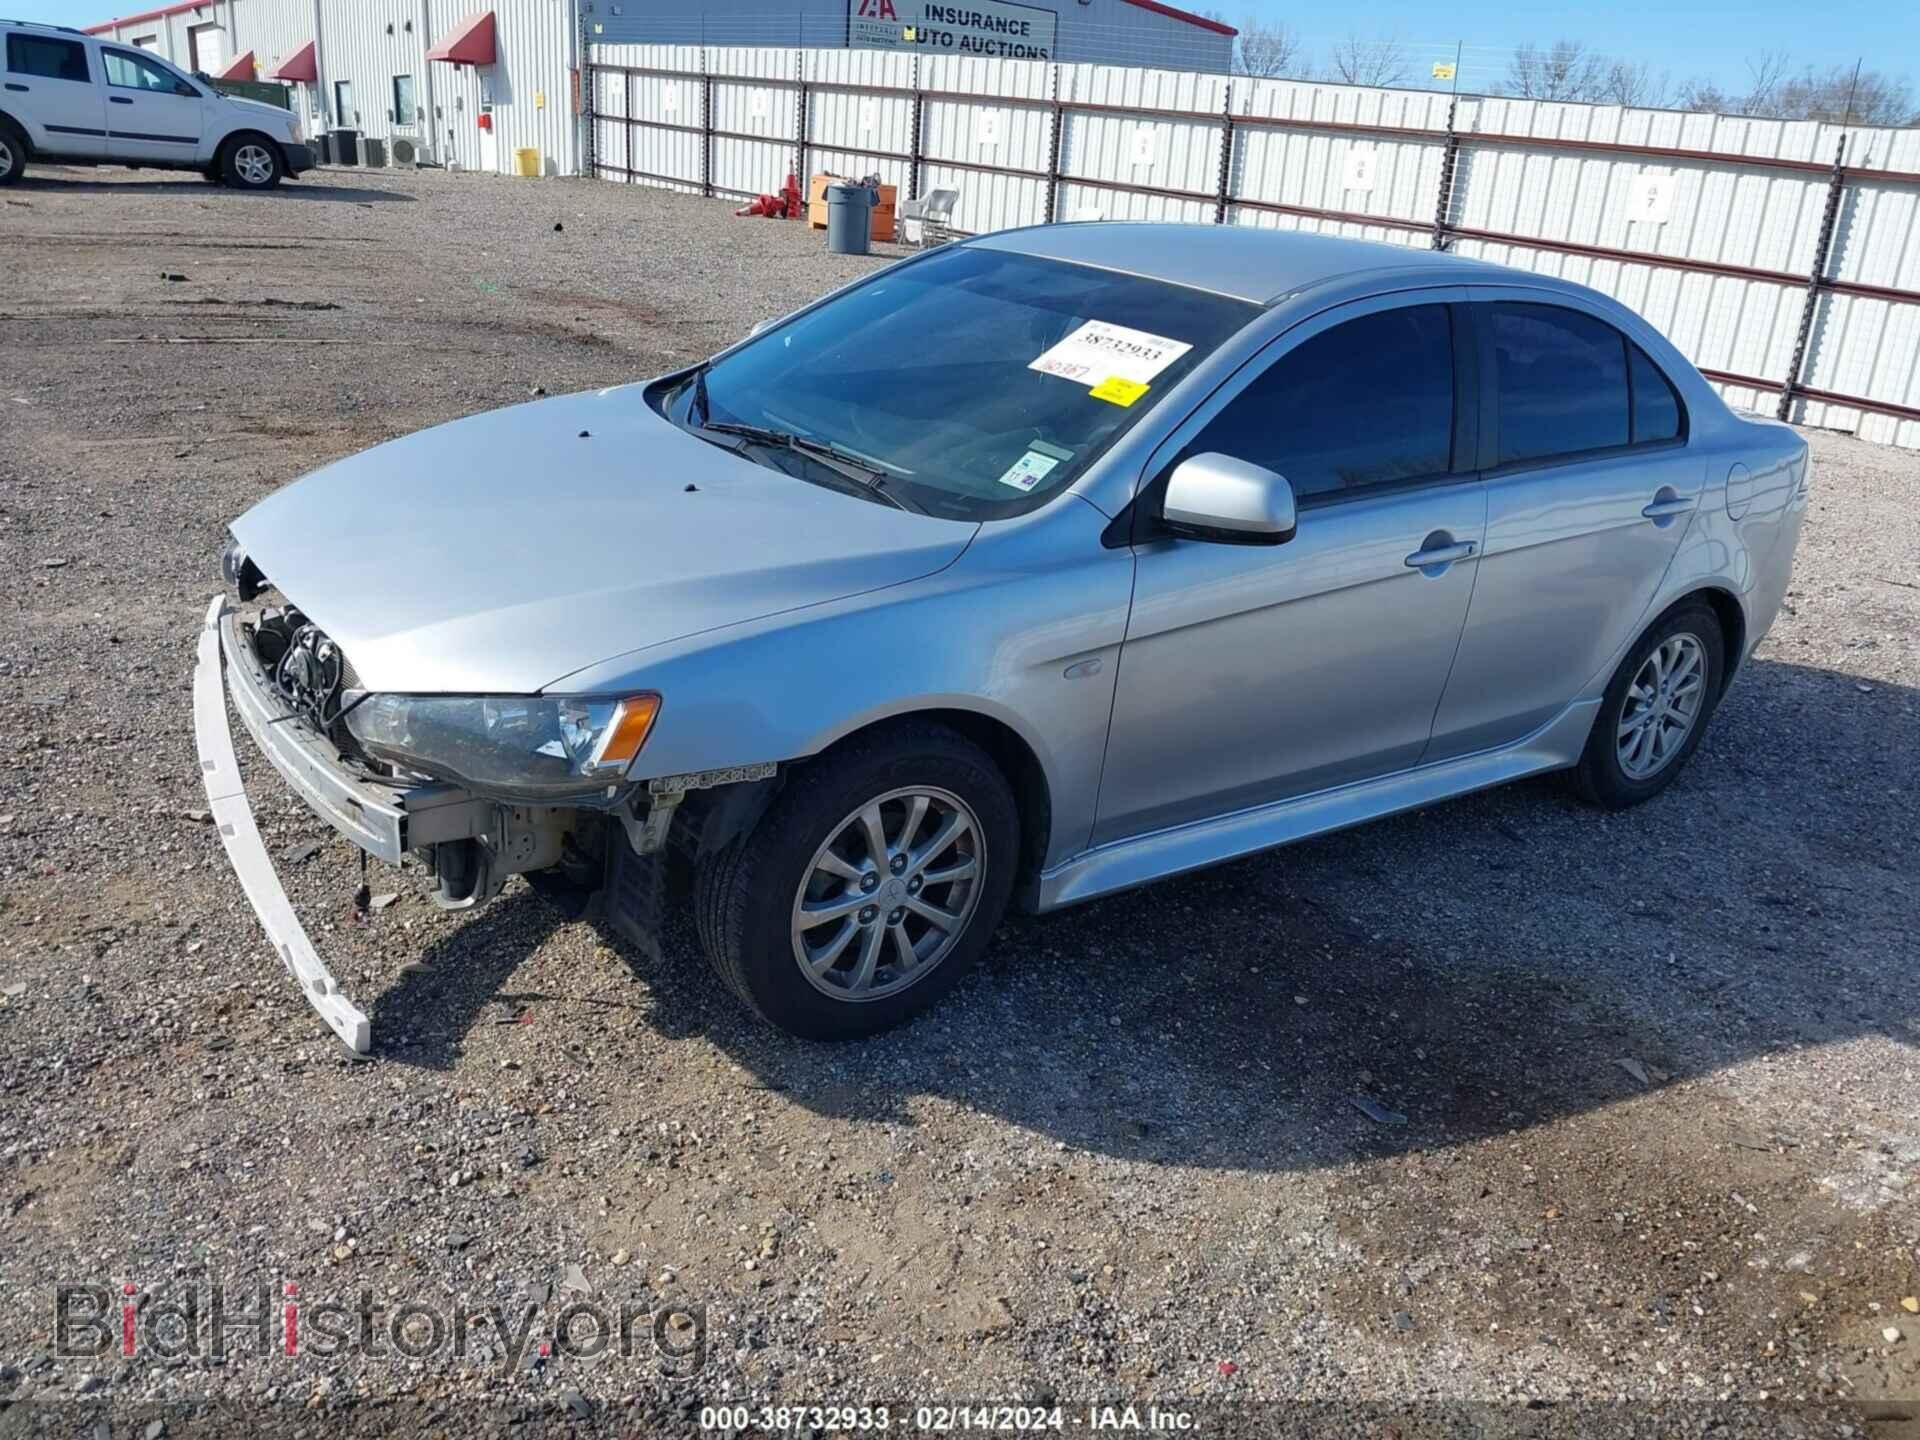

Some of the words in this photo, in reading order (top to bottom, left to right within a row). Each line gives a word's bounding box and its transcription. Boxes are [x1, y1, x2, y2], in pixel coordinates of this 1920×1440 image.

[924, 4, 1031, 36] INSURANCE
[902, 27, 954, 47] UTO
[958, 35, 1049, 59] AUCTIONS
[1077, 331, 1163, 361] 38732933
